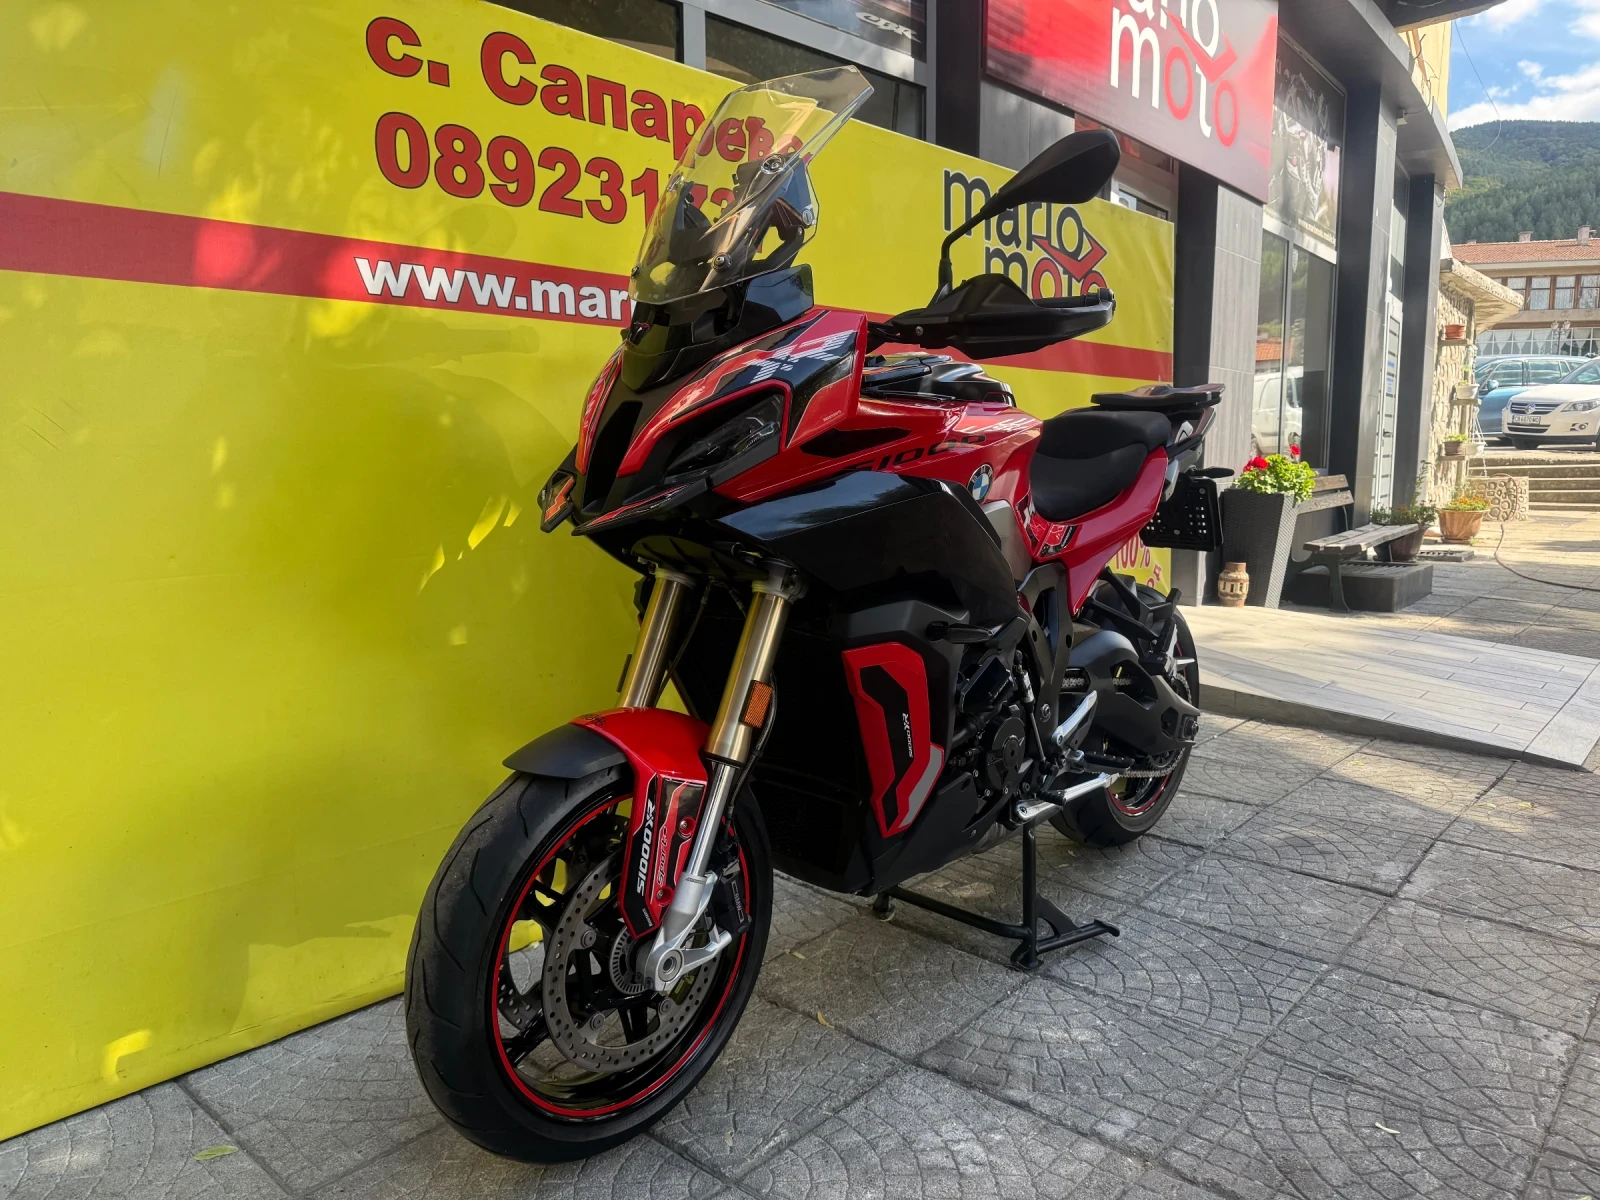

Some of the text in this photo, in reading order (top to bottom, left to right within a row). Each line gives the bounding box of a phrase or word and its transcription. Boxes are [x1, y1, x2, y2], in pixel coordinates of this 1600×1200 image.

[855, 12, 922, 44] CBR
[1110, 7, 1239, 148] moto
[354, 256, 637, 321] www.mar
